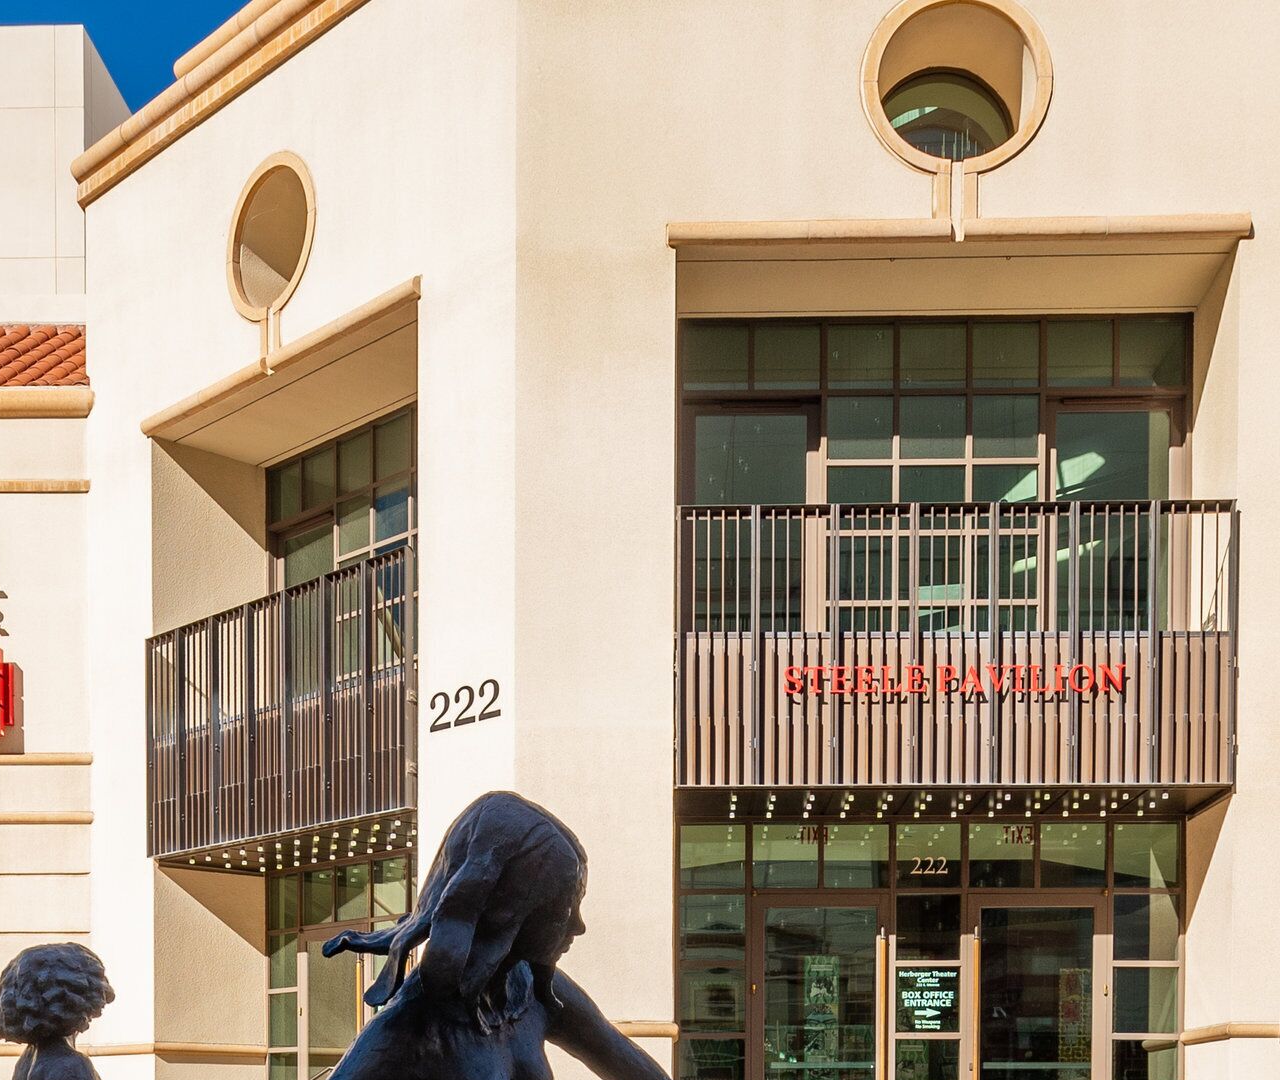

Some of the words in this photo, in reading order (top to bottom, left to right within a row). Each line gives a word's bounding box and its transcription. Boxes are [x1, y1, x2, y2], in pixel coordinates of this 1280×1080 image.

[784, 664, 926, 694] STEELE
[936, 663, 1126, 694] PAVILION
[430, 679, 501, 733] 222
[910, 857, 949, 875] 222
[902, 991, 921, 999] BOX
[923, 991, 954, 999] OFFICE
[904, 999, 952, 1007] ENTRANCE
